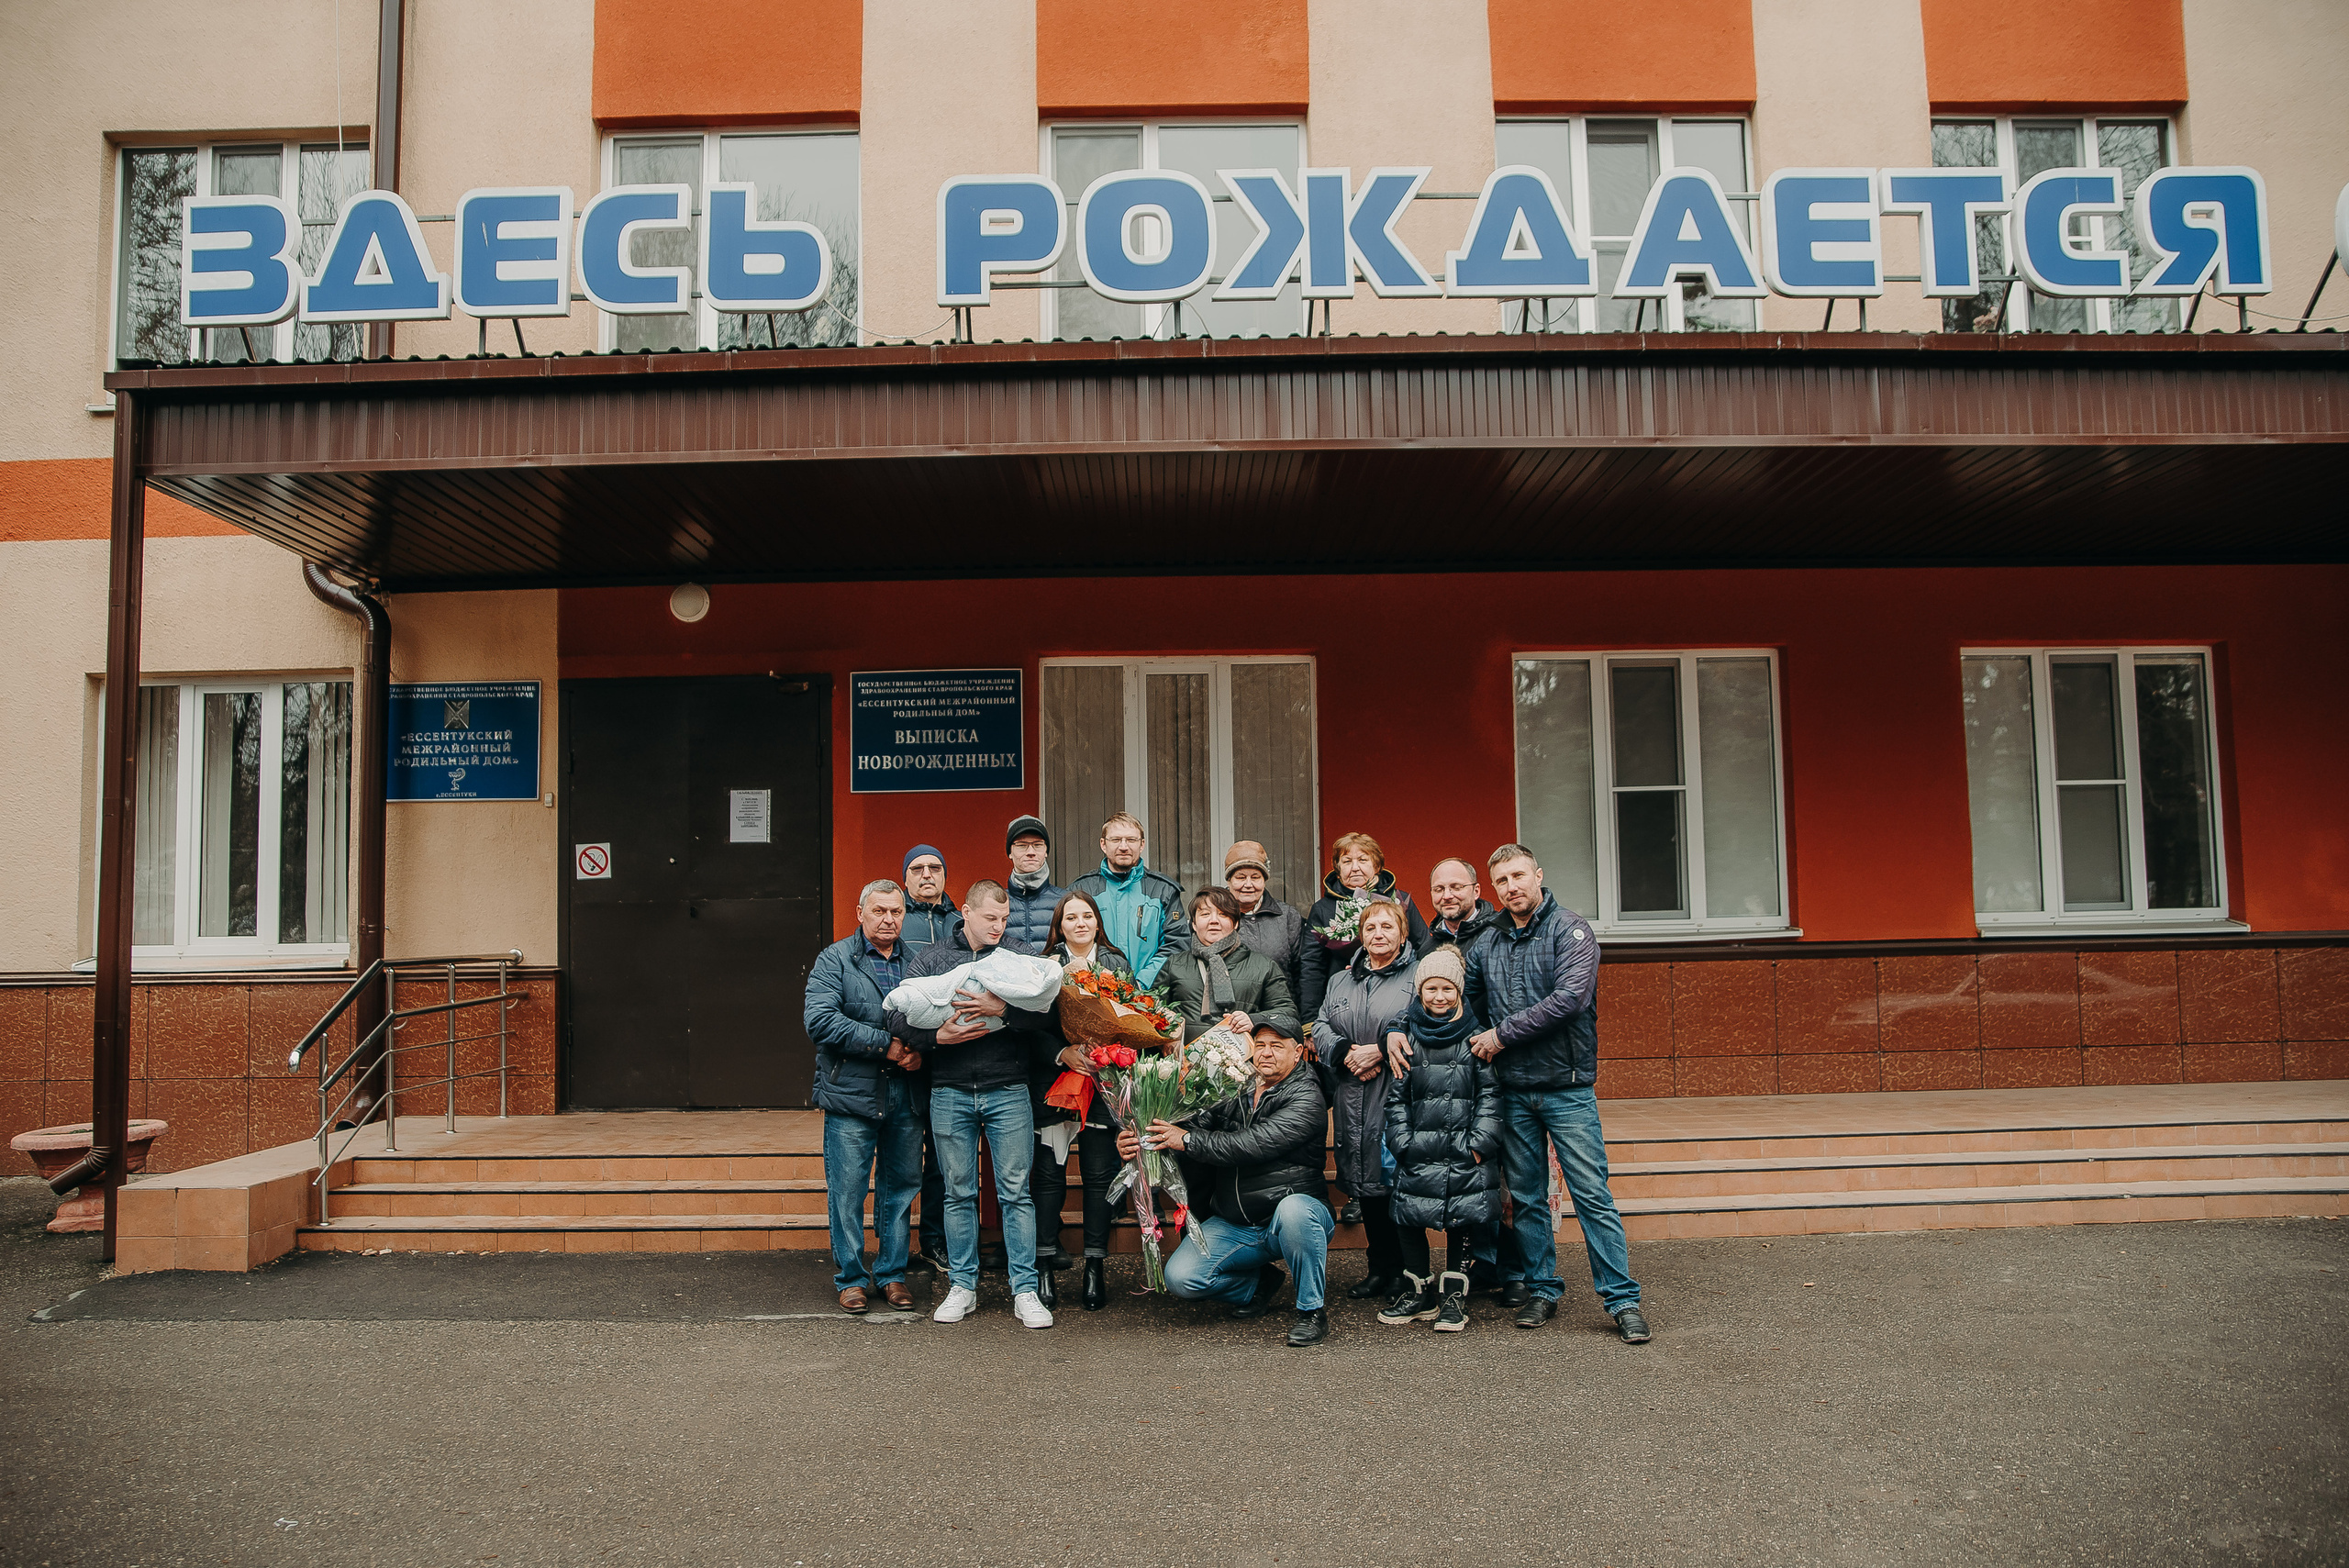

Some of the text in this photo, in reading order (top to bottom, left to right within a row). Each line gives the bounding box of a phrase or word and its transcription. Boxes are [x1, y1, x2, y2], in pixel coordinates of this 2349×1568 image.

[182, 182, 830, 327] ЗДЕСЬ
[936, 164, 2273, 307] РОЖДАЕТСЯ
[858, 696, 1016, 707] «ЕССЕНТУКСКИЙ МЕЖРАЙОННЫЙ
[893, 708, 981, 718] РОДИЛЬНЫЙ ДОМ»
[401, 729, 513, 742] «ЕССЕНТУКСКИЙ
[895, 728, 979, 744] ВЫПИСКА
[401, 742, 512, 754] МЕЖРАЙОННЫЙ
[394, 755, 519, 768] РОДИЛЬНЫЙ ДОМ»
[857, 753, 1017, 771] НОВОРОЖДЕННЫХ
